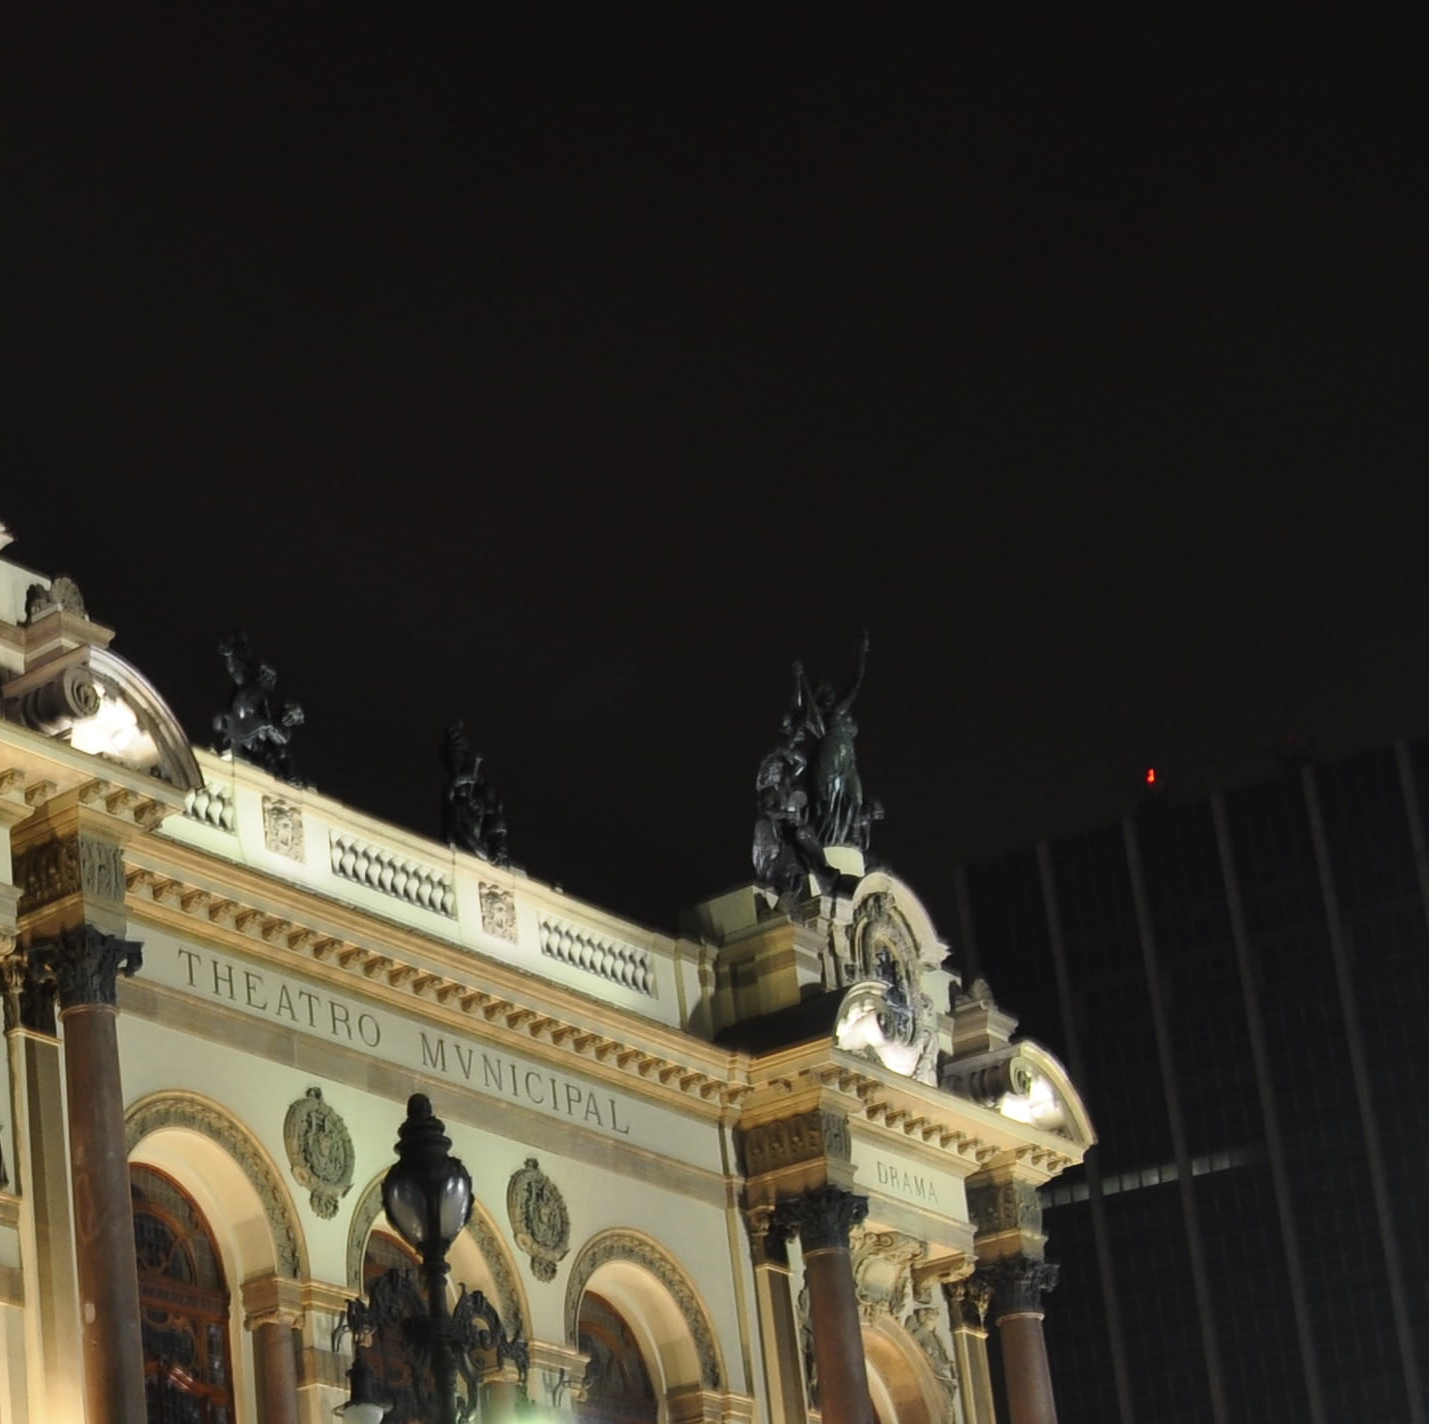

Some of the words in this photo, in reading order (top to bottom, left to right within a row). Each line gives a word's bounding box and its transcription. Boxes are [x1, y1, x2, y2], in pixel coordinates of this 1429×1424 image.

[178, 948, 382, 1048] THEATRO
[419, 1031, 630, 1134] MVNICIPAL
[876, 1160, 939, 1204] DRAMA
